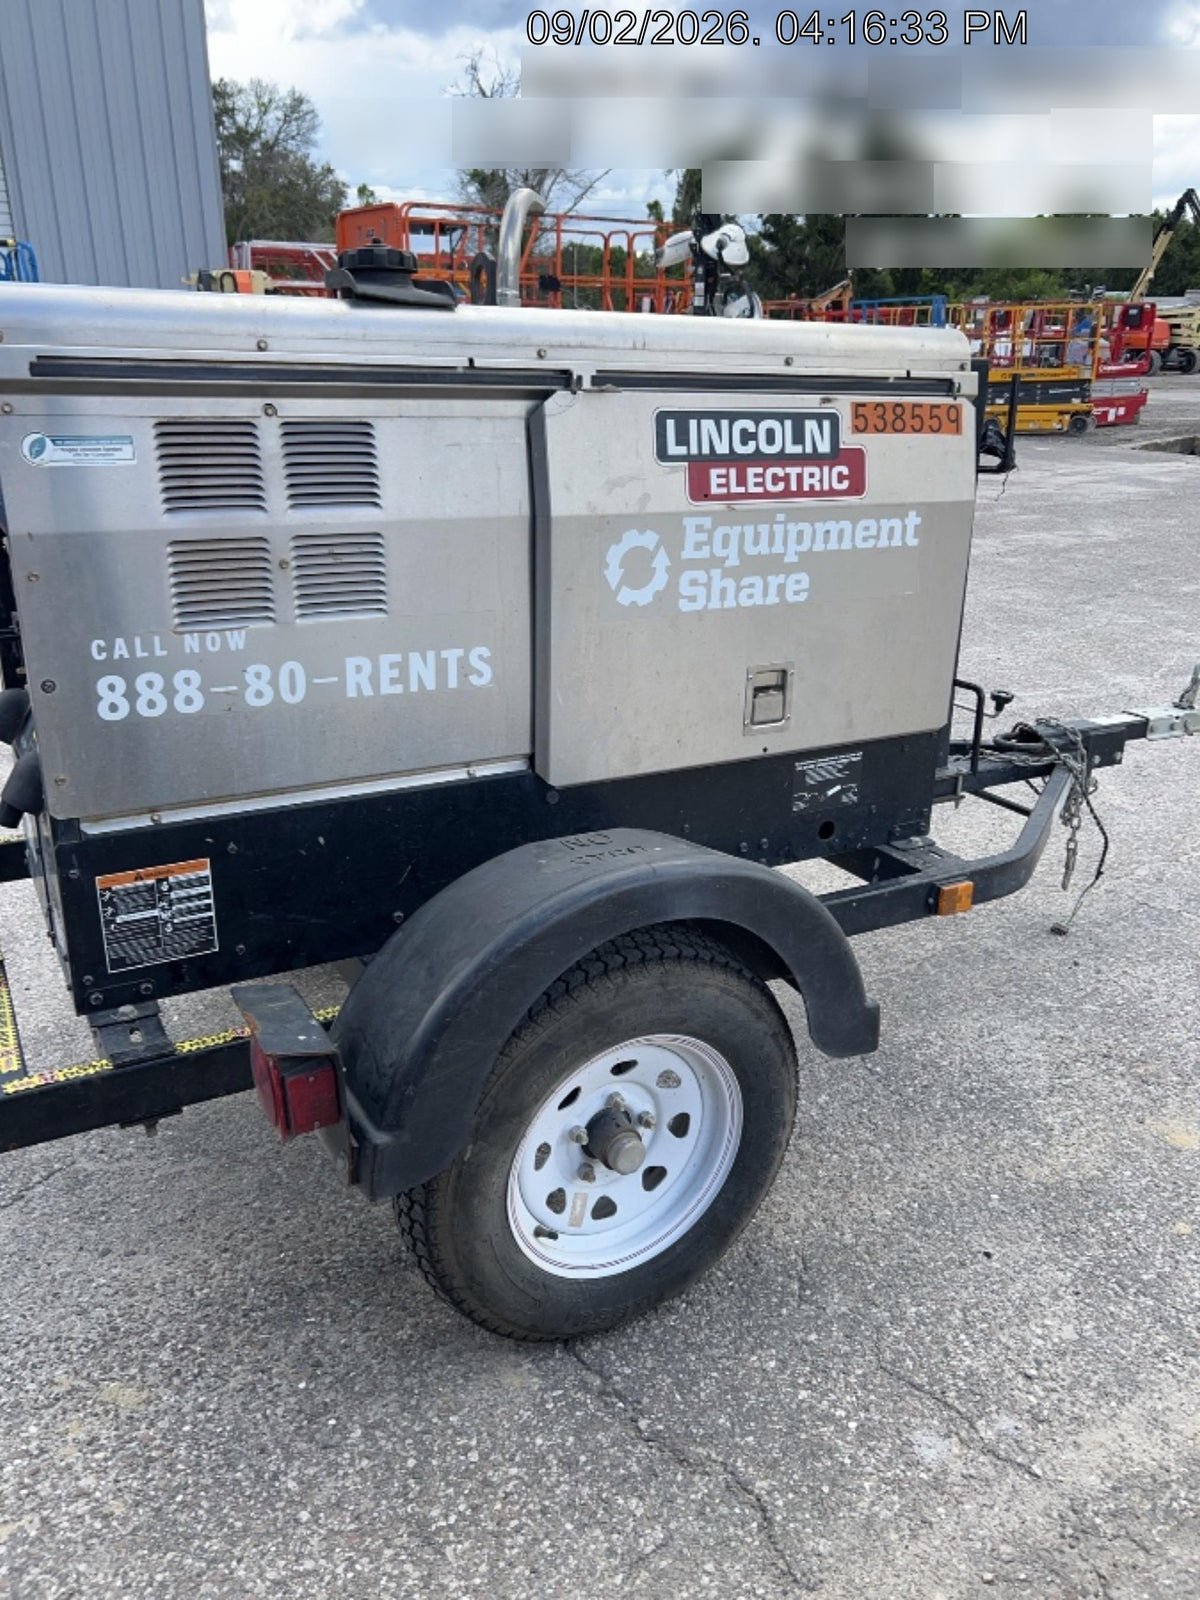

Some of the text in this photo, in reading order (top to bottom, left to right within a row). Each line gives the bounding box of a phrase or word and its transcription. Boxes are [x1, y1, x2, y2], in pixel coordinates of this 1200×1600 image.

[853, 403, 961, 433] 538559
[665, 418, 831, 456] LINCOLN
[709, 465, 850, 494] ELECTRIC
[681, 510, 922, 567] Equipment
[678, 568, 810, 612] Share
[91, 630, 247, 661] CALL NOW
